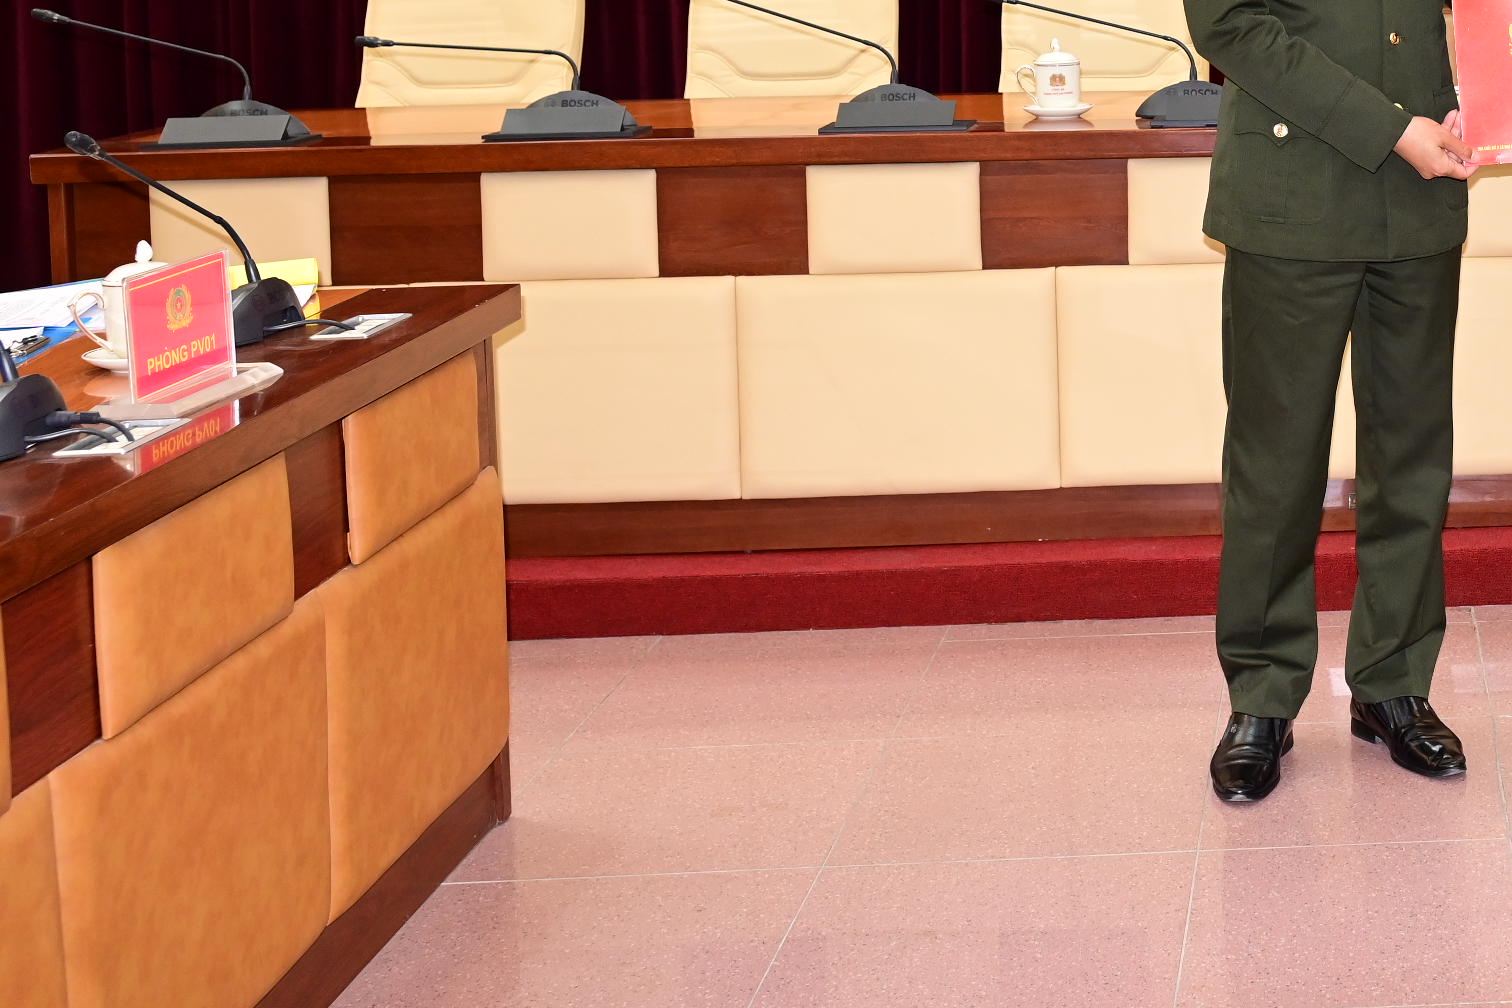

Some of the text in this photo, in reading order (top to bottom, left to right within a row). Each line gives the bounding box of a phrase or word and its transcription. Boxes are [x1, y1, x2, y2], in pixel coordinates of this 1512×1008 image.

[880, 92, 916, 102] BOSCH
[560, 99, 599, 108] BOSCH
[147, 332, 216, 376] PHÒNG PV01
